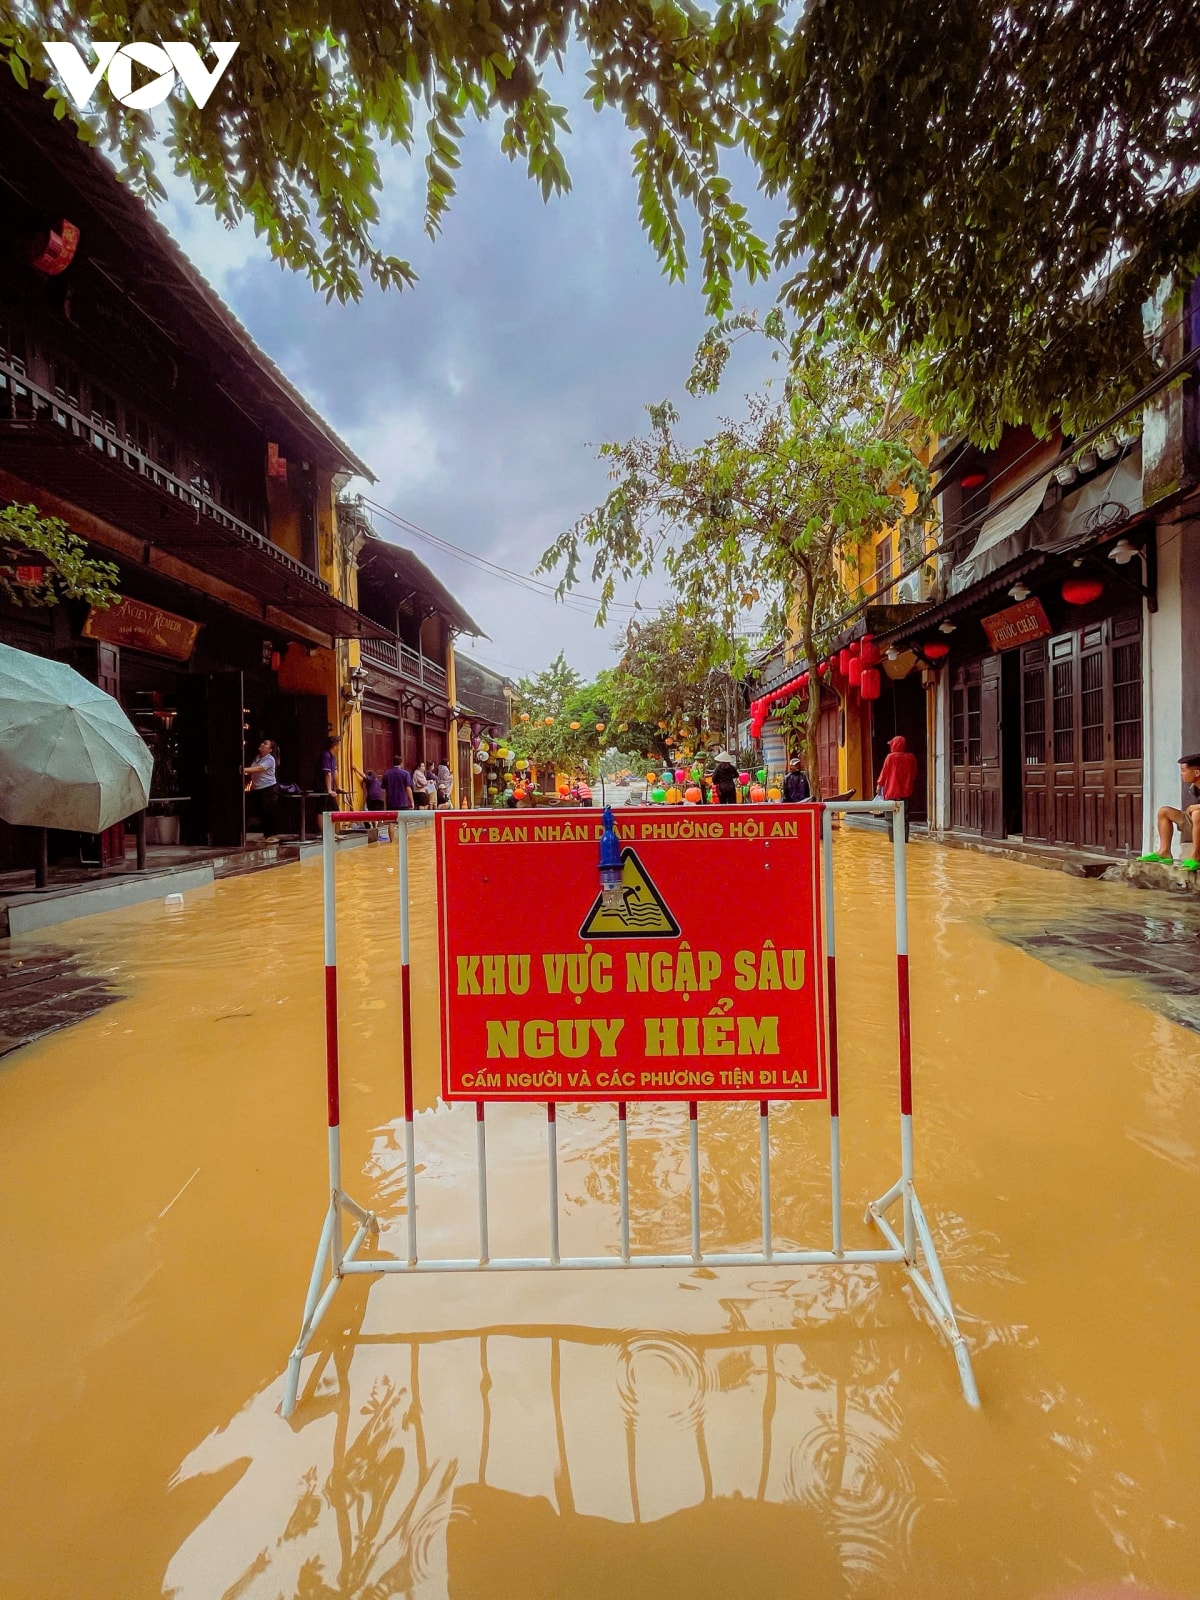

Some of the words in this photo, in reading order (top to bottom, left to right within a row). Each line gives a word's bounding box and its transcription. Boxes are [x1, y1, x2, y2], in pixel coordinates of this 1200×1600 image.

[458, 823, 484, 843] ỦY
[488, 826, 528, 842] BAN
[534, 822, 588, 841] NHÂN
[641, 819, 724, 839] PHƯỜNG
[729, 818, 764, 841] HỘI
[770, 821, 798, 837] AN
[456, 955, 531, 996] KHU
[542, 943, 613, 1005] VỰC
[626, 940, 722, 1001] NGẬP
[734, 939, 806, 991] SÂU
[486, 1019, 625, 1059] NGUY
[644, 998, 780, 1057] HIỂM
[461, 1068, 501, 1087] CẤM
[506, 1069, 562, 1087] NGƯỜI
[567, 1069, 592, 1087] VÀ
[596, 1068, 636, 1087] CÁC
[640, 1070, 715, 1086] PHƯƠNG
[719, 1067, 754, 1089] TIỆN
[759, 1070, 777, 1085] ĐI
[782, 1070, 808, 1089] LẠI
